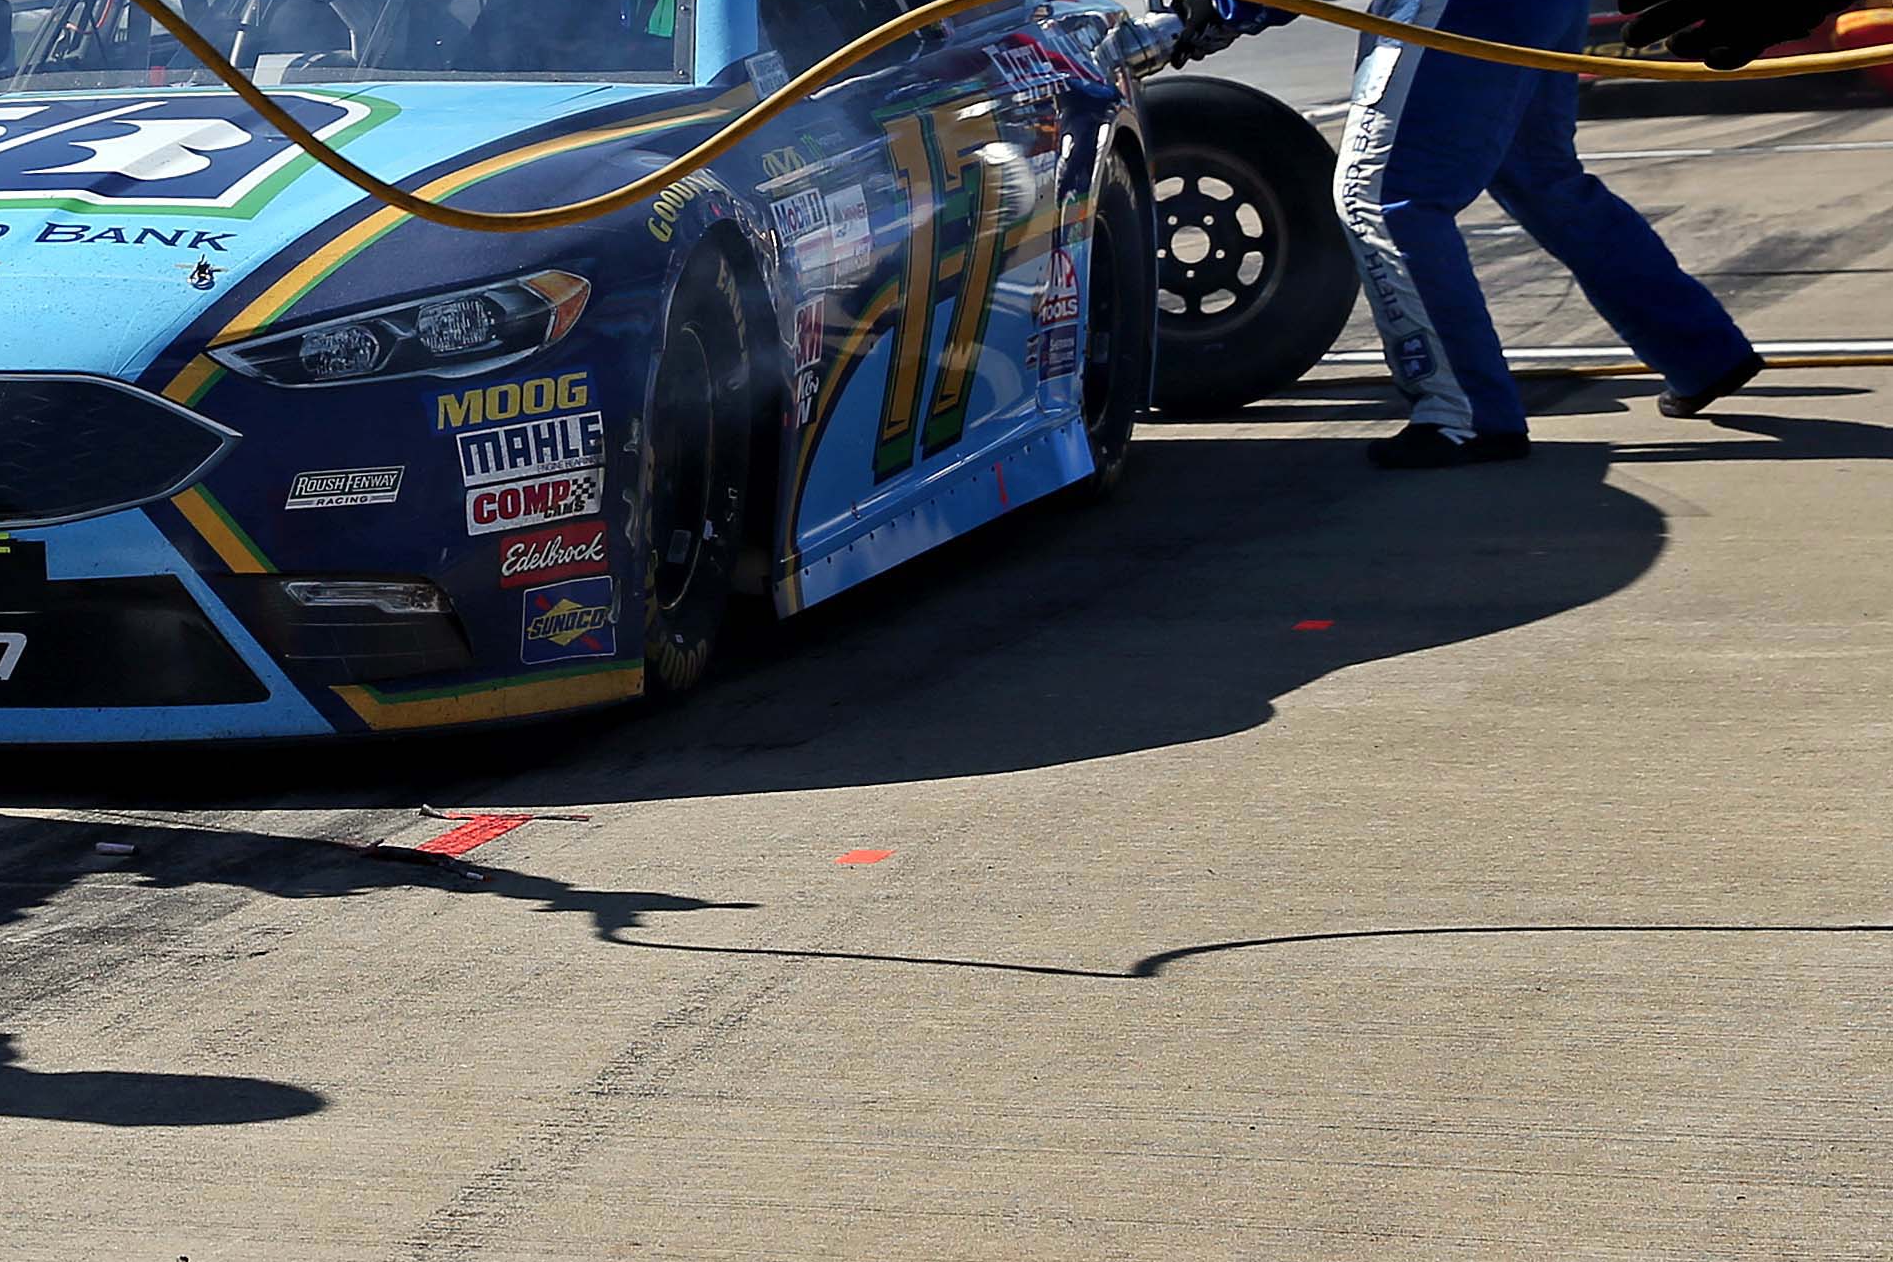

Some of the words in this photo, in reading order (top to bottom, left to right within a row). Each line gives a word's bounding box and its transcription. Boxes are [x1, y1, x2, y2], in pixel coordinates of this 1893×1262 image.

[35, 219, 238, 254] BANK
[437, 371, 588, 430] MOOG
[459, 414, 603, 477] MAHLE
[295, 476, 346, 496] ROUSH
[344, 474, 398, 493] FENWAY
[316, 495, 369, 507] RACING
[473, 479, 571, 525] COMP
[544, 499, 586, 520] CAMS
[501, 532, 605, 577] Edelbrock
[530, 607, 608, 638] SUNOCO
